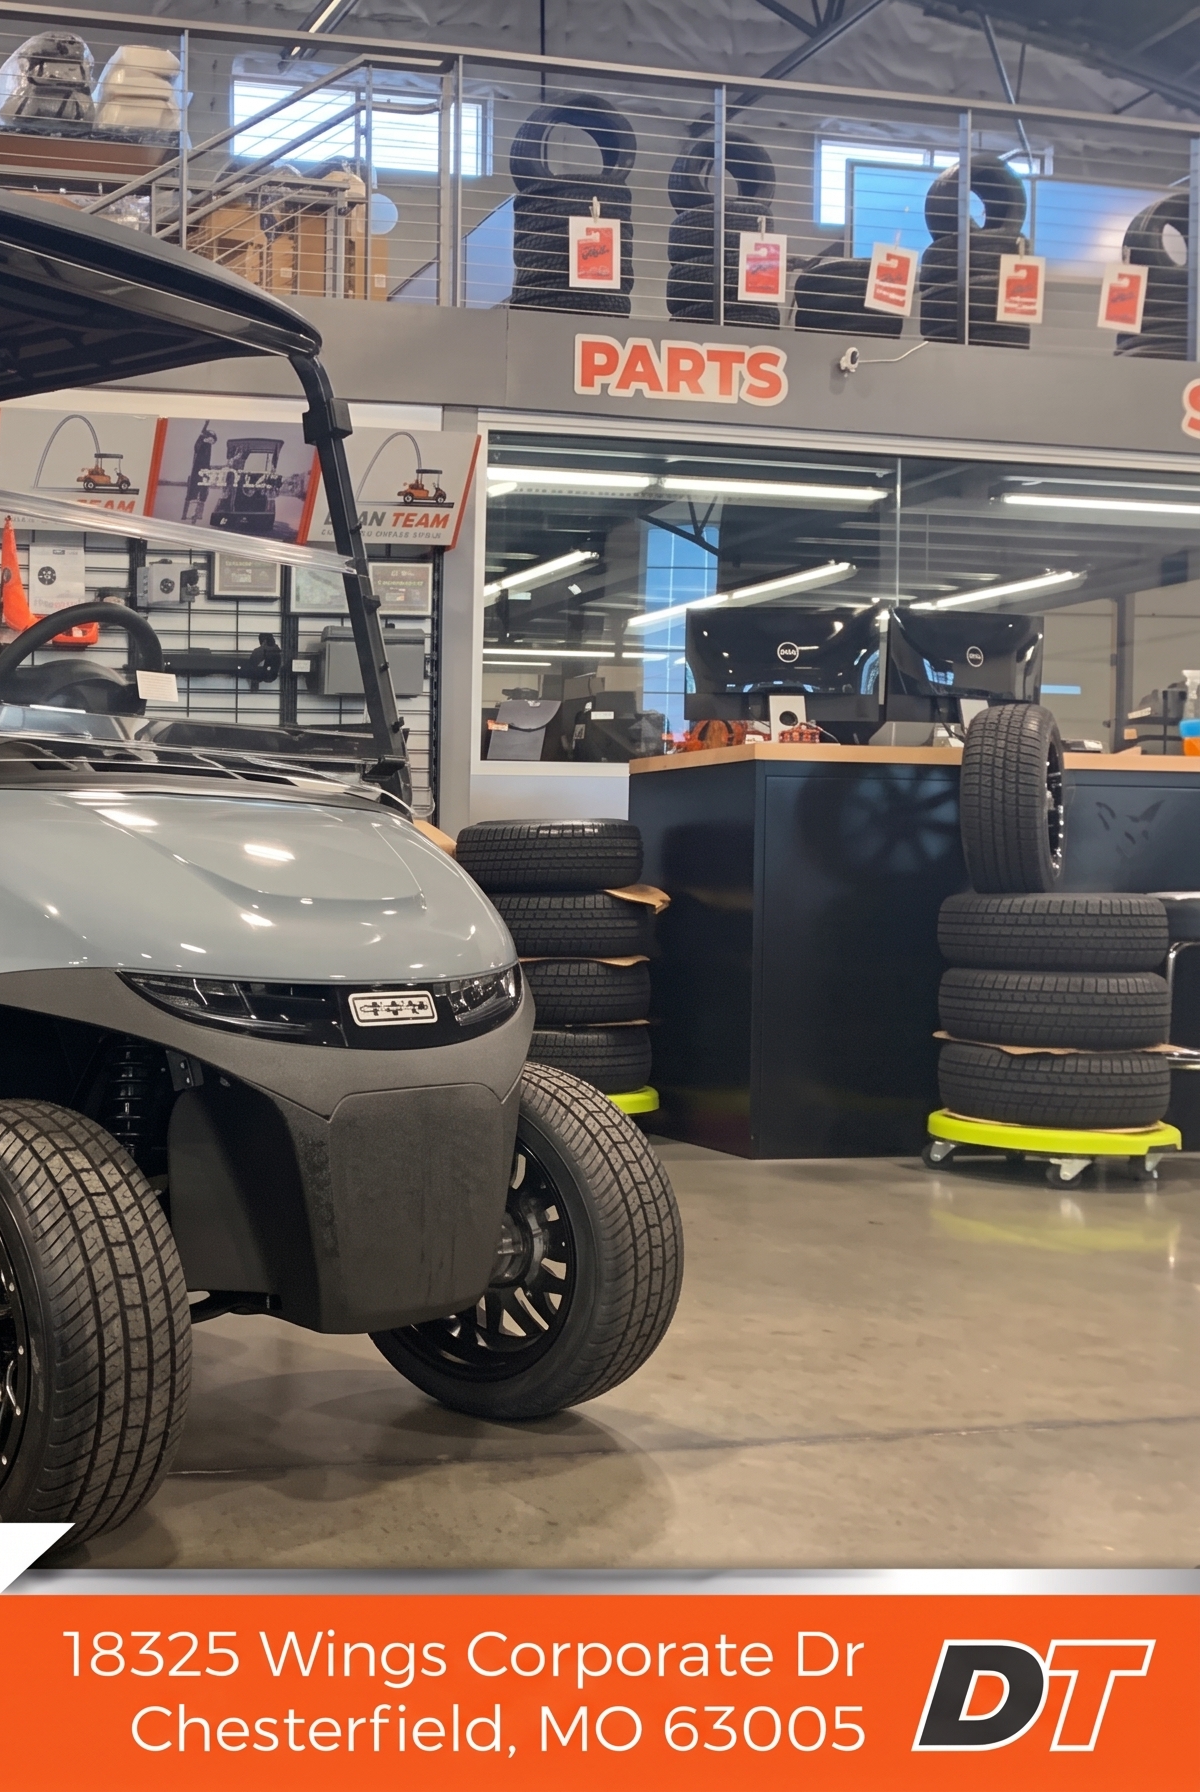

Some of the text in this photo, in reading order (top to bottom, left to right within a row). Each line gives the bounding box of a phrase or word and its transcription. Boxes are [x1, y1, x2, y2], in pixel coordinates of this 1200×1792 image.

[579, 338, 785, 402] PARTS
[323, 510, 451, 529] AN TEAM
